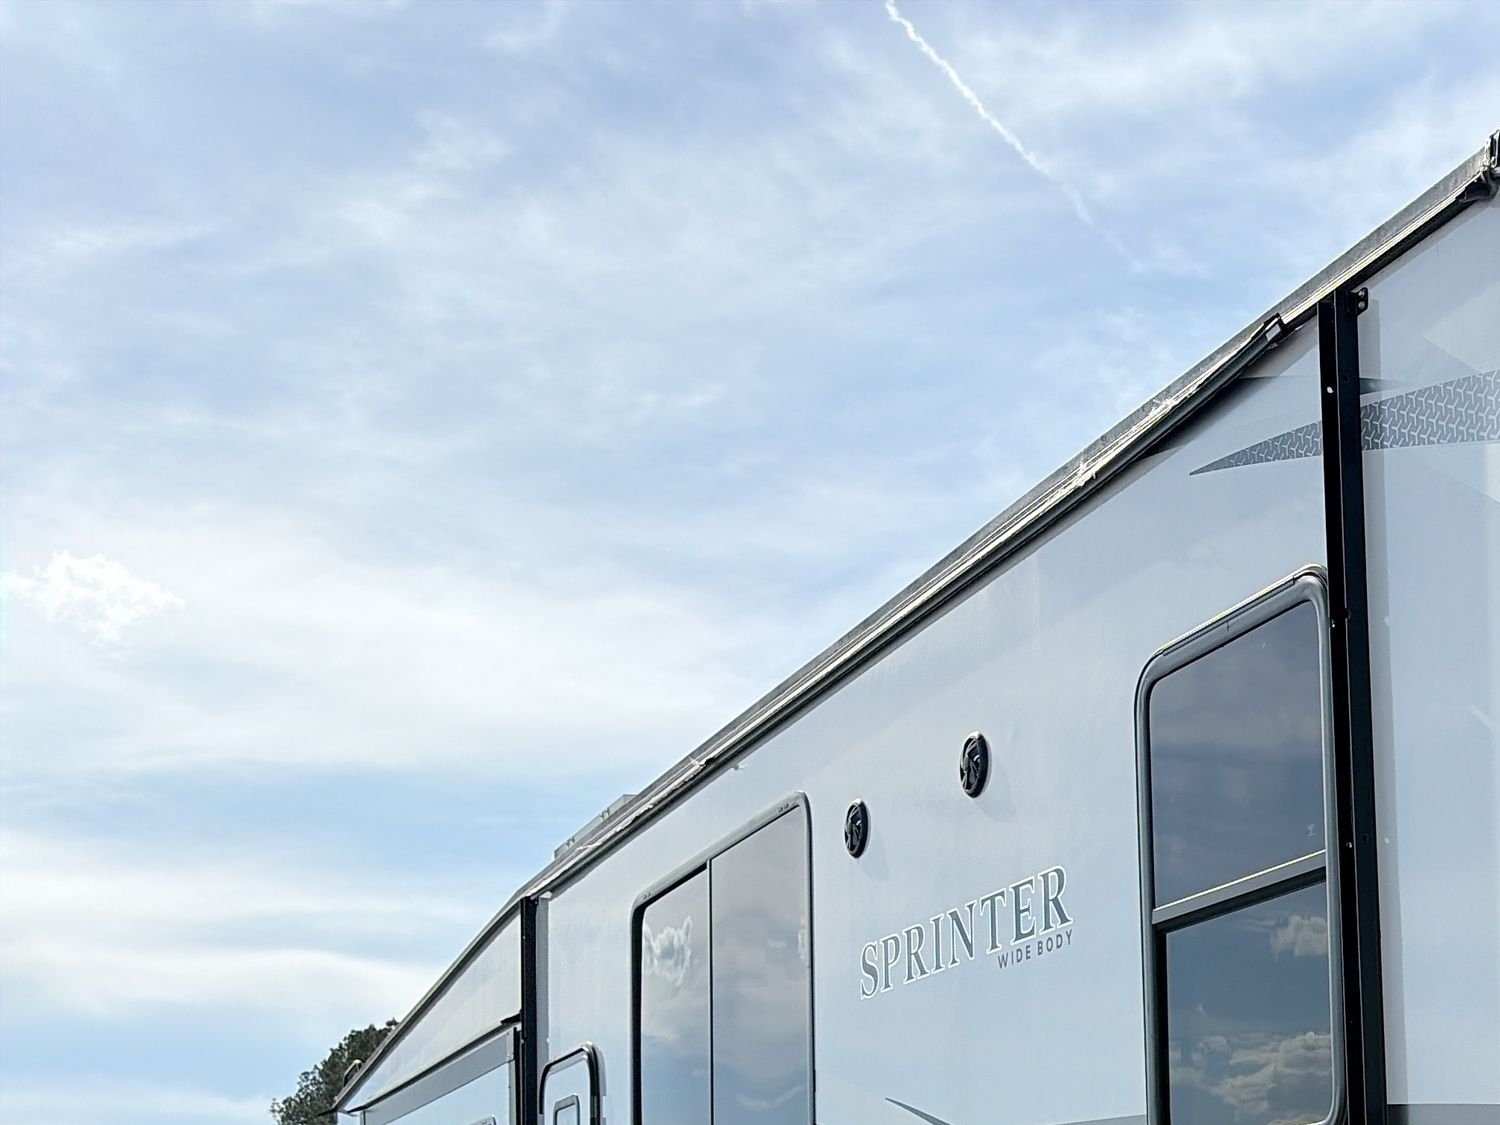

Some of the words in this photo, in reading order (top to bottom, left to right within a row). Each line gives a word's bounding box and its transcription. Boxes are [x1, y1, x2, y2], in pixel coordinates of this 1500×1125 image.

[859, 864, 1073, 1000] SPRINTER
[998, 944, 1031, 969] WIDE
[1037, 929, 1073, 956] BODY
